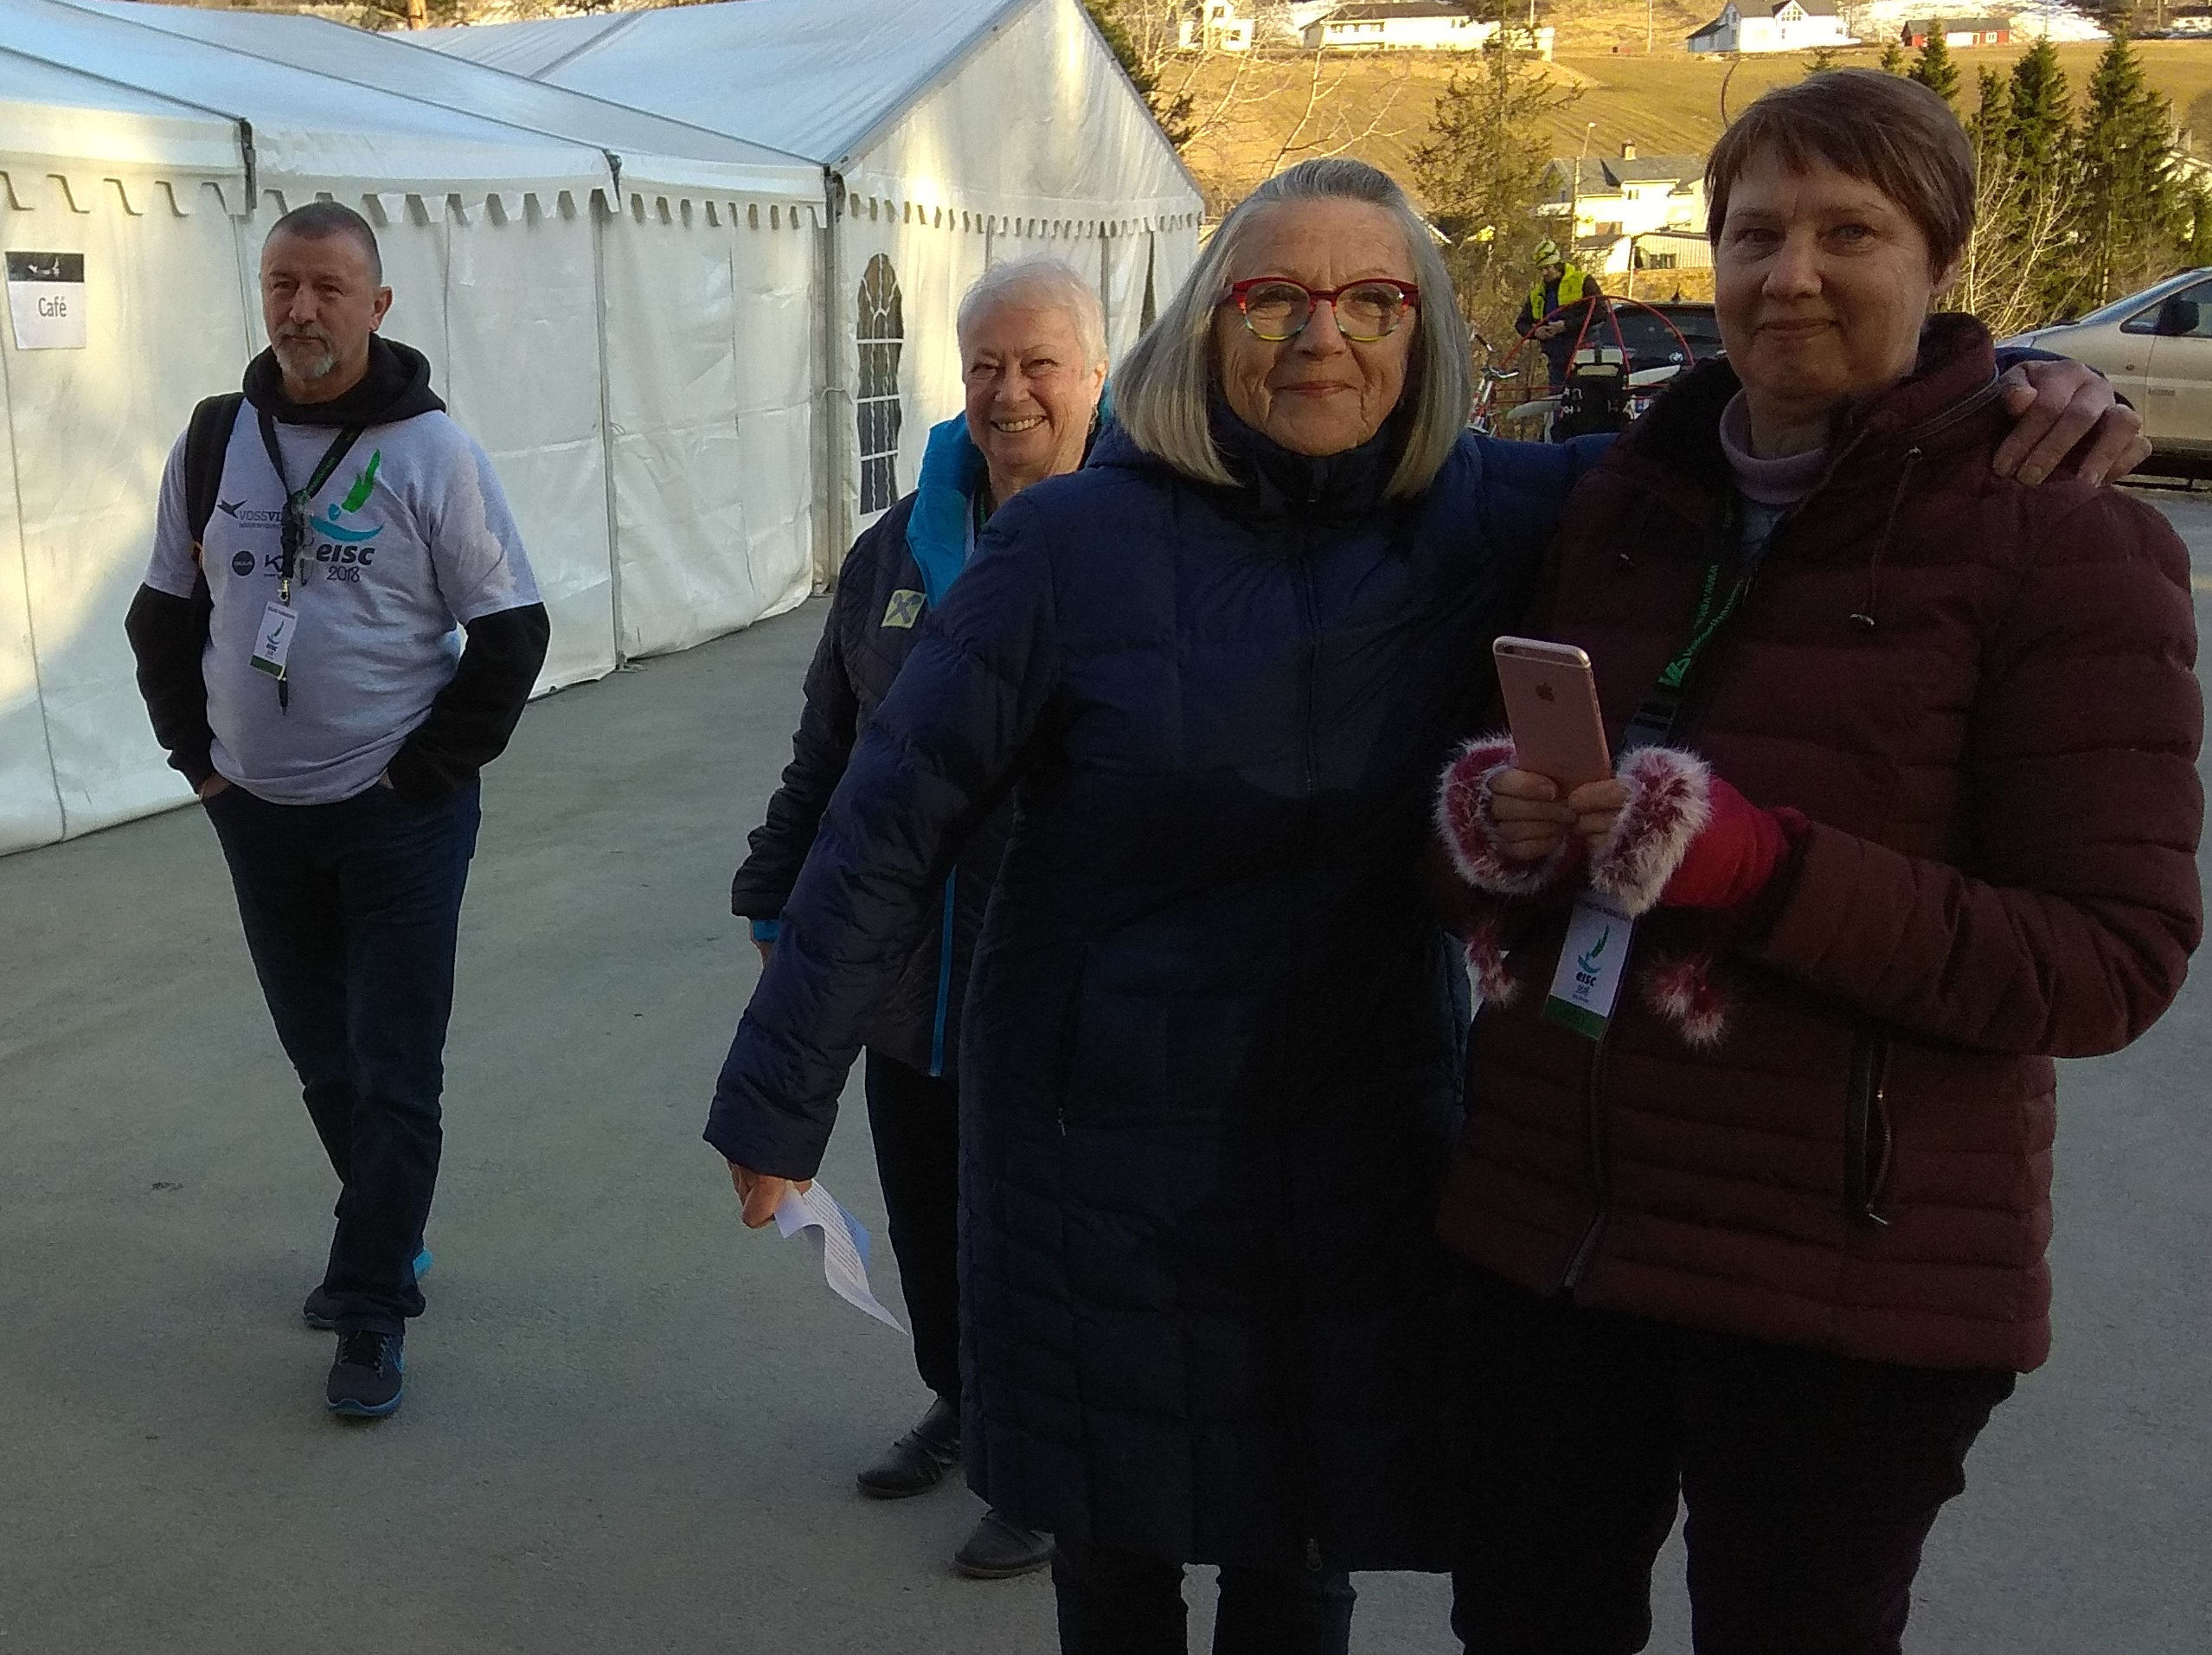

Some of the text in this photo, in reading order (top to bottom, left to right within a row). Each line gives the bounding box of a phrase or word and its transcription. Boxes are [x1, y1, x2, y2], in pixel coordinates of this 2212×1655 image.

[38, 296, 67, 318] Café
[240, 510, 284, 522] VOSSVI
[326, 566, 360, 582] 2018
